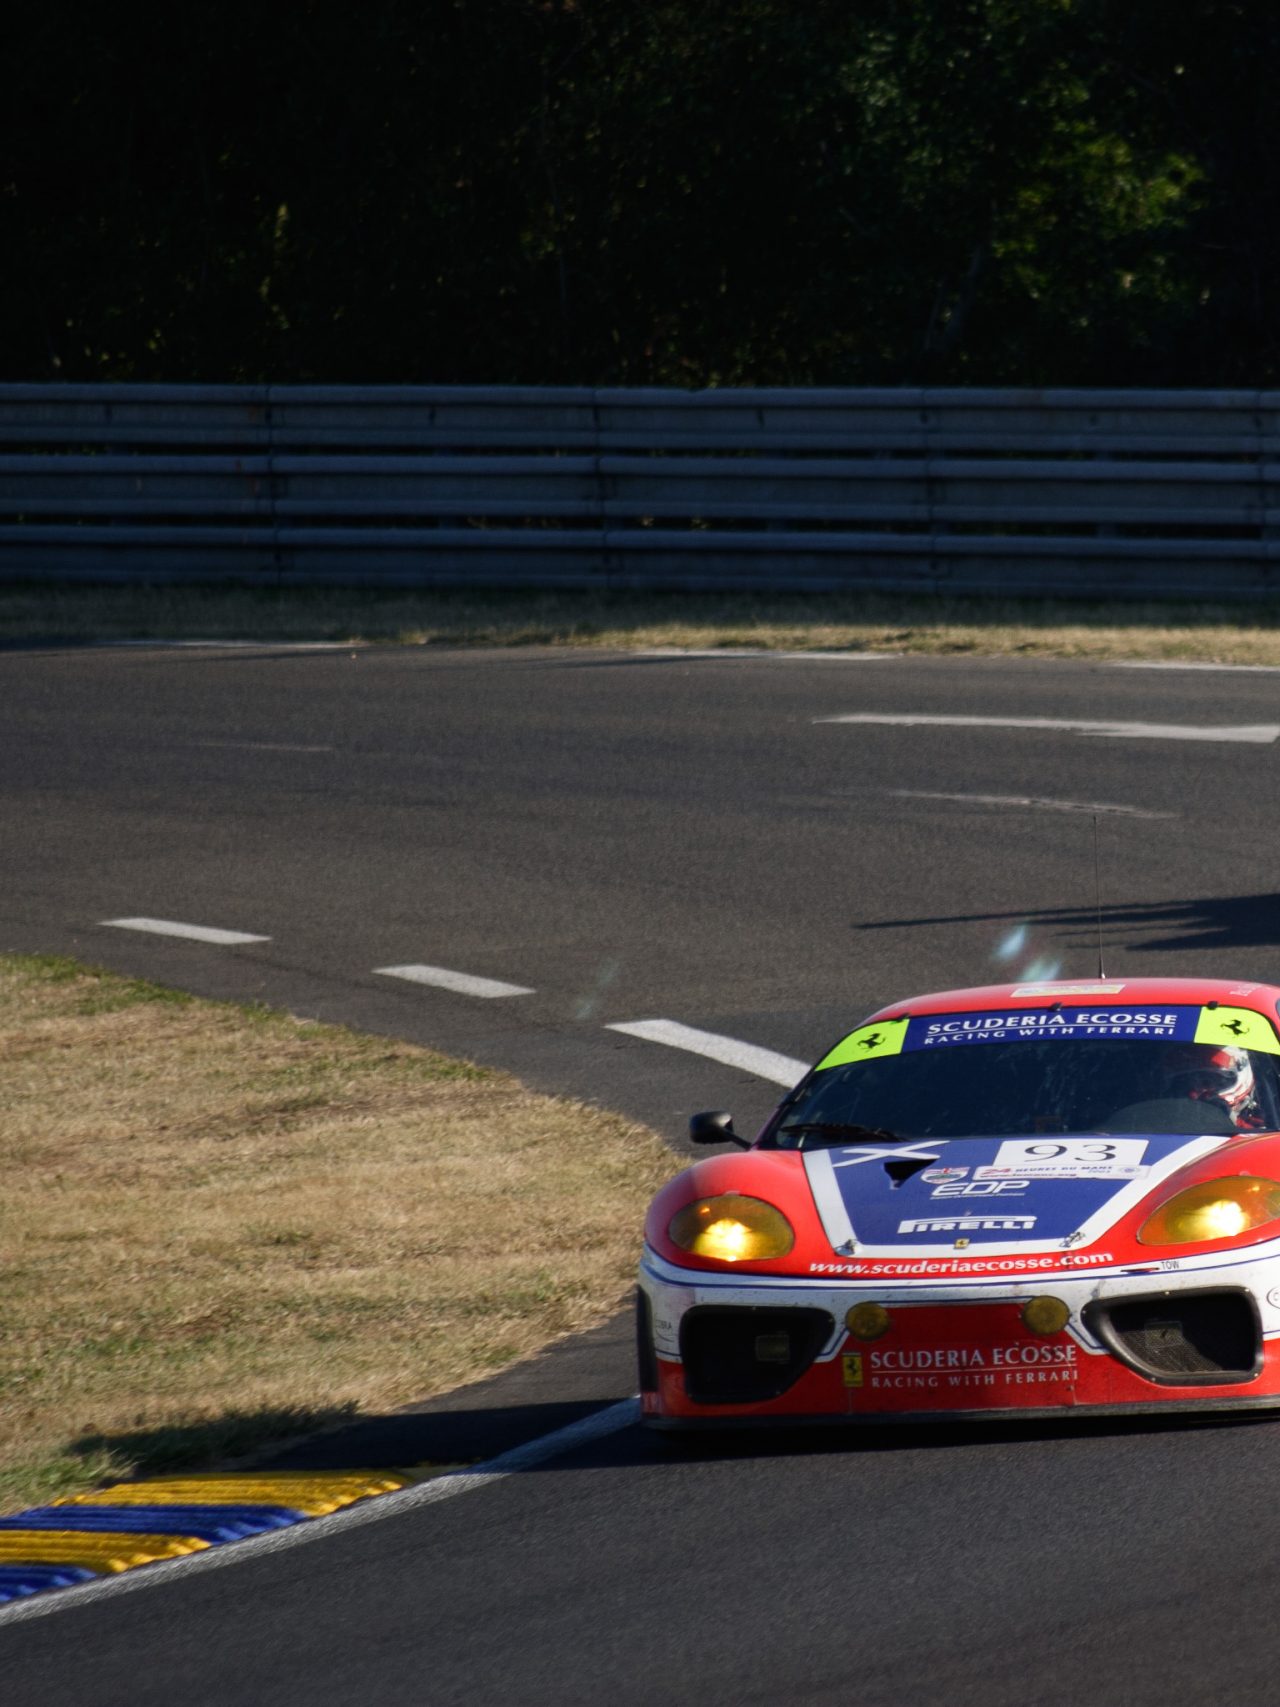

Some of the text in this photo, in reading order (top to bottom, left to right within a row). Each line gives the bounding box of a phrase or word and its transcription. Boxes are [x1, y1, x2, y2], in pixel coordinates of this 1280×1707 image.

[927, 1013, 1178, 1035] SCUDERIA ECOSSE
[924, 1027, 1174, 1045] RACING WITH FERRARI
[1024, 1144, 1116, 1162] 93
[931, 1180, 1030, 1196] EDP
[898, 1215, 1037, 1234] PIRELLI
[809, 1252, 1114, 1275] www.scuderiaecosse.com
[1161, 1260, 1179, 1270] TOW
[870, 1345, 1077, 1369] SCUDERIA ECOSSE
[872, 1370, 1078, 1388] RACING WITH FERRARI
